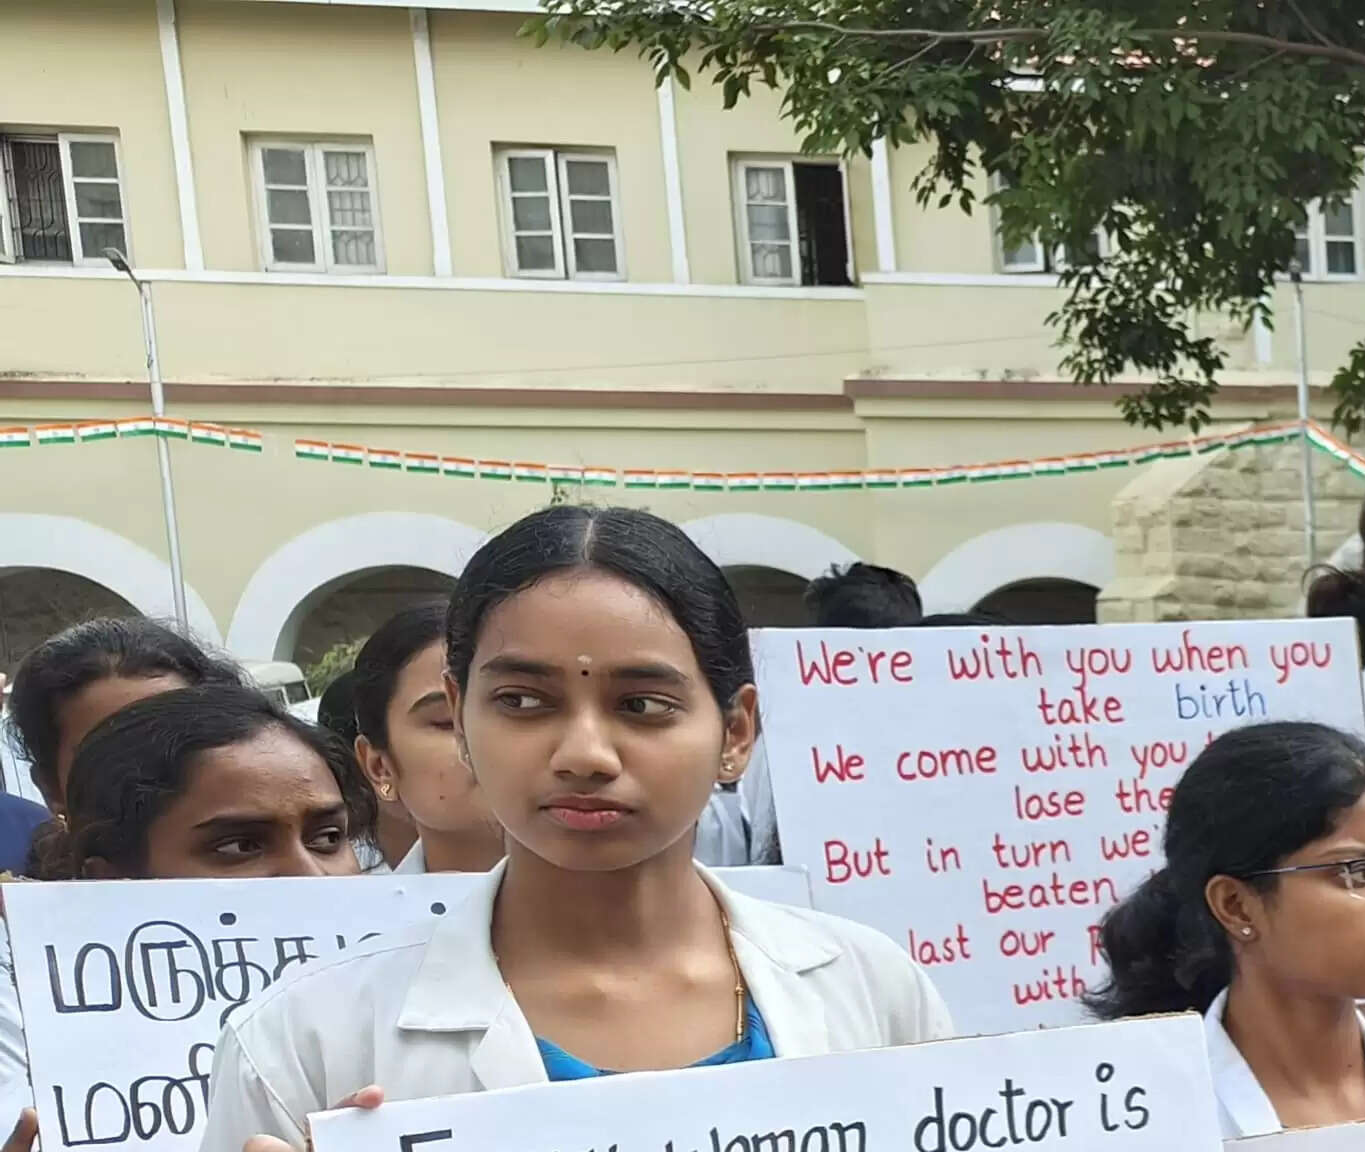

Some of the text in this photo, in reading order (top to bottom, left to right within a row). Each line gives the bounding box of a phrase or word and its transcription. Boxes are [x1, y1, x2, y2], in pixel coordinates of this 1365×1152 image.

[797, 629, 1333, 690] We're with you when you
[1038, 681, 1267, 726] take birth
[812, 734, 1187, 784] We come with you
[1014, 785, 1086, 820] lose
[824, 833, 1071, 884] But in turn
[983, 872, 1118, 914] beaten
[909, 924, 972, 965] last
[1000, 928, 1055, 957] our
[1093, 1061, 1150, 1133] is
